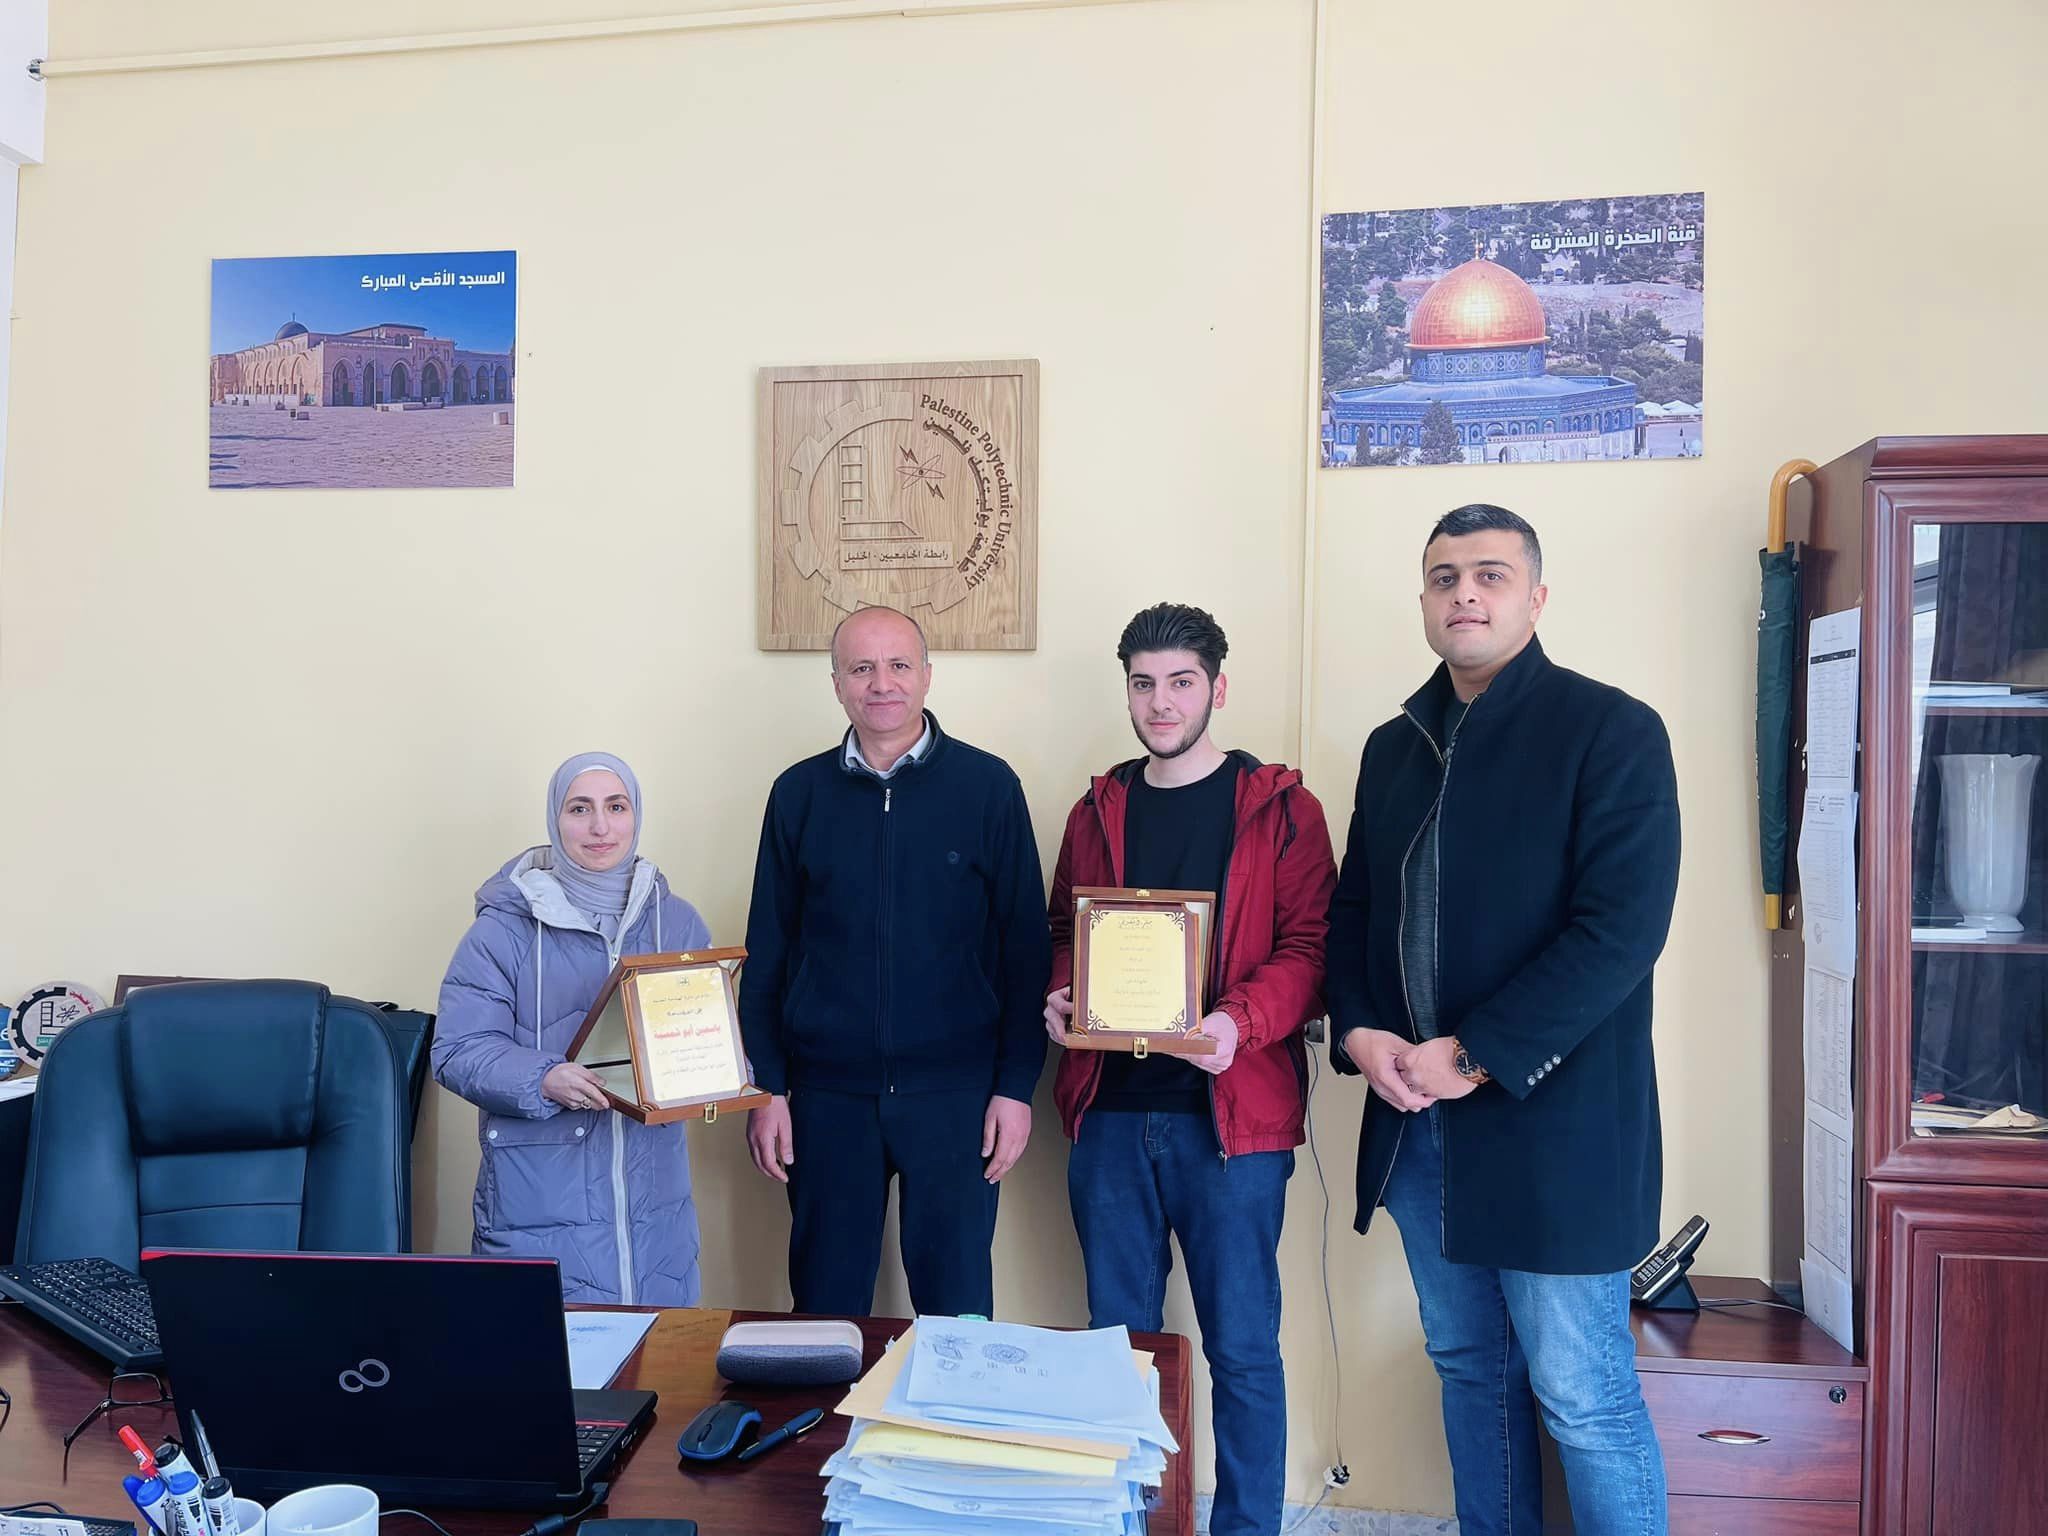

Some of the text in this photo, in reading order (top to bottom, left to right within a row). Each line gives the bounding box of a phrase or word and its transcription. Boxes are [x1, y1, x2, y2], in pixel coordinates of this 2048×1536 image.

[1530, 224, 1696, 253] قبة الصخرة المشرفة
[361, 269, 505, 291] المسجد الأقصى المبارك
[923, 417, 972, 456] فلسطين
[920, 394, 1013, 591] Palestine Polytechnic University
[844, 551, 871, 563] الخليل
[879, 549, 921, 562] الجامعيين
[923, 548, 949, 561] رابطة
[956, 531, 989, 573] جامعة
